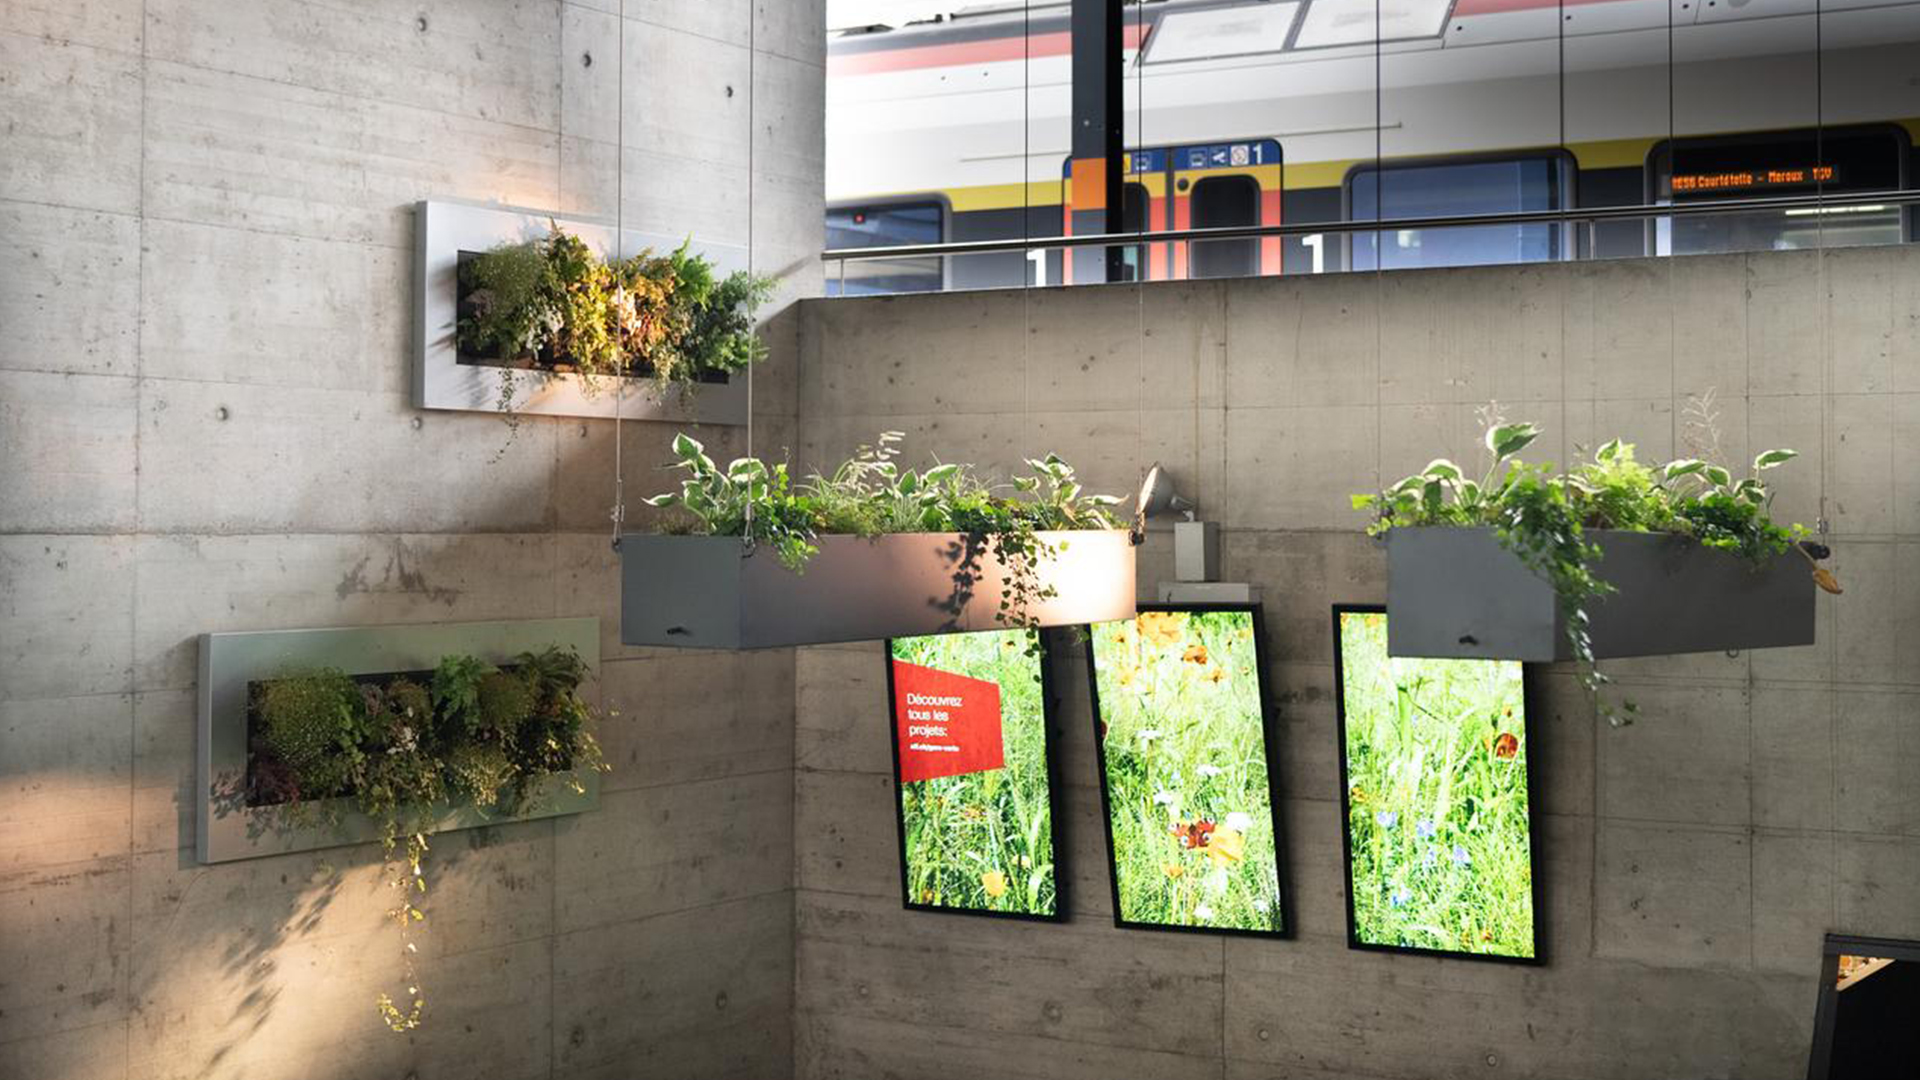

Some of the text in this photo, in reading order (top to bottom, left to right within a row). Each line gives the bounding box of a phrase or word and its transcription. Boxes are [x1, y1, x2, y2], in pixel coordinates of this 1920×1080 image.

[1252, 144, 1263, 165] 1
[1302, 233, 1325, 274] 1
[1026, 248, 1047, 287] 1
[906, 692, 963, 707] Découvrez
[907, 709, 949, 722] tous les
[909, 724, 948, 738] projets:
